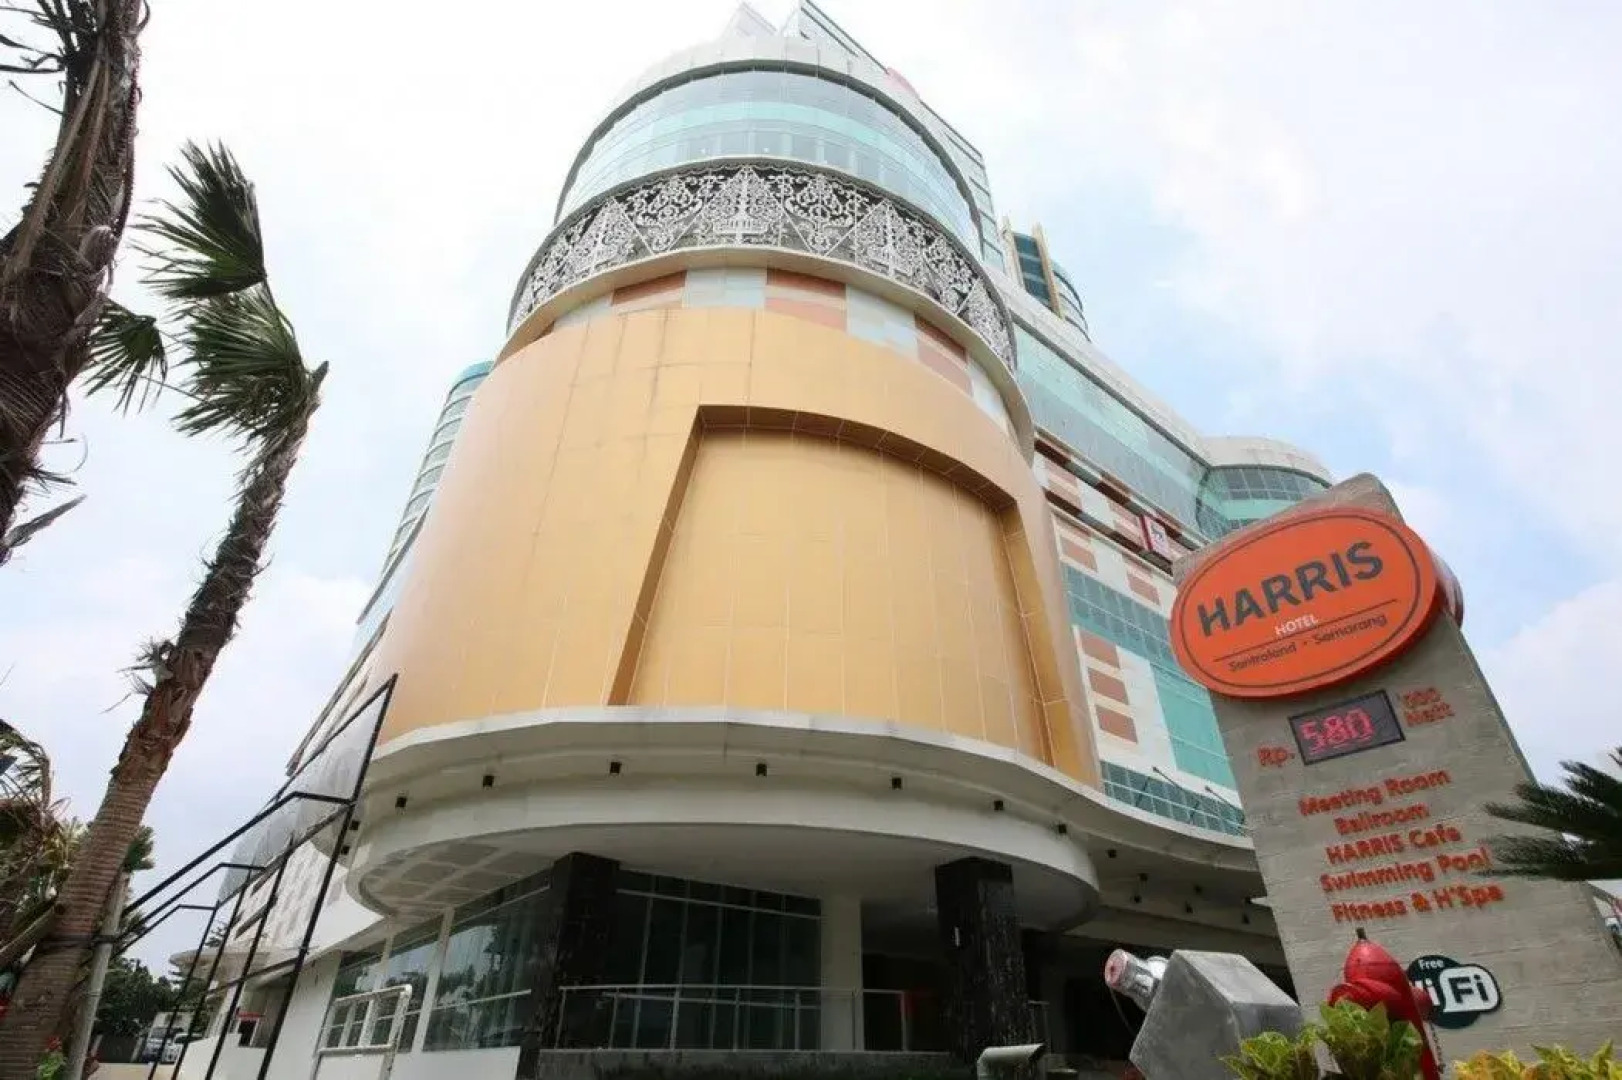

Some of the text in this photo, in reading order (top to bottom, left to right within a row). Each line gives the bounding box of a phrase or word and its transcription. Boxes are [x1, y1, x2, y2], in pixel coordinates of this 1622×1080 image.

[1197, 541, 1384, 637] HARRIS
[1274, 613, 1319, 636] HOTEL
[1301, 706, 1376, 756] 580
[1298, 770, 1451, 816] Meeting Room
[1334, 803, 1430, 836] Ballroom
[1326, 823, 1461, 864] HARRIS Cafe
[1319, 846, 1493, 893] Swimming Pool
[1332, 899, 1407, 923] Fitness
[1417, 959, 1445, 970] Free
